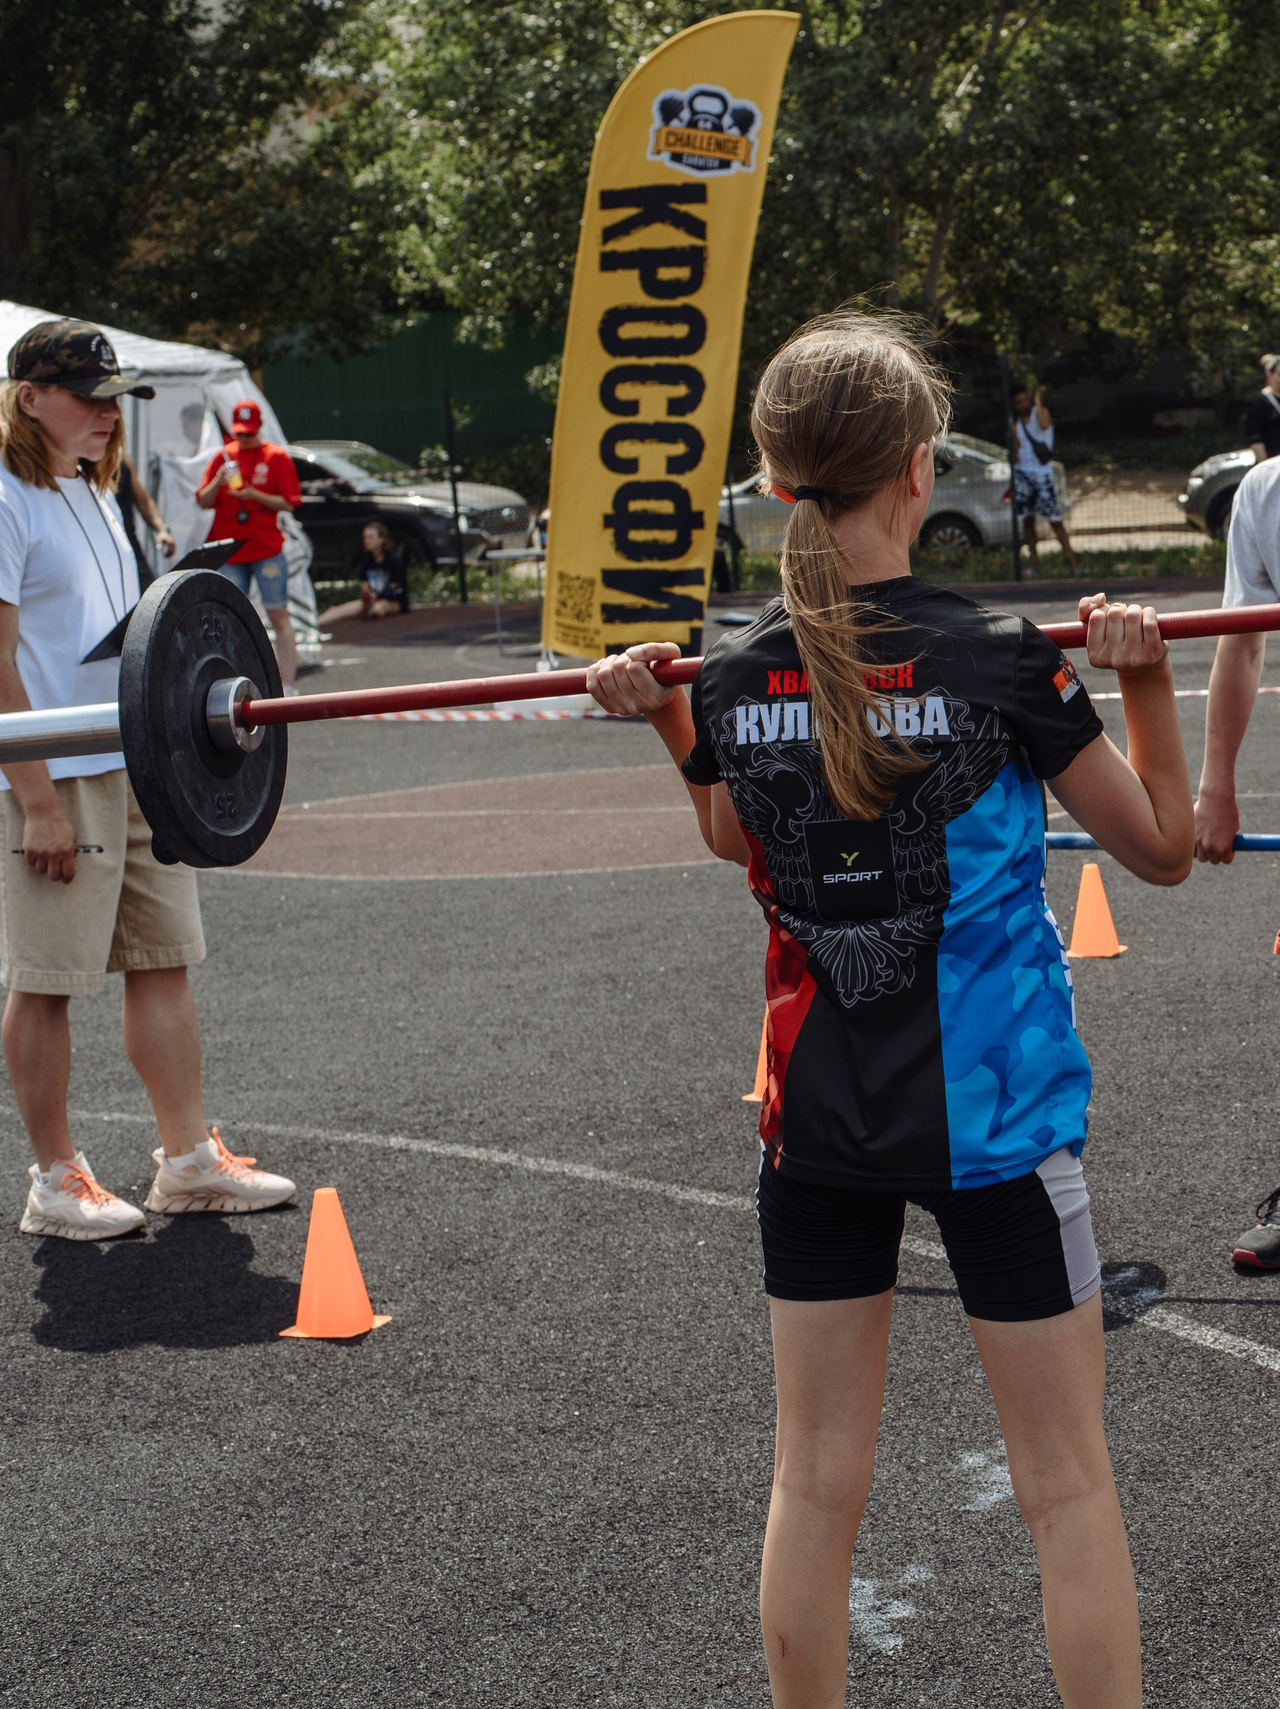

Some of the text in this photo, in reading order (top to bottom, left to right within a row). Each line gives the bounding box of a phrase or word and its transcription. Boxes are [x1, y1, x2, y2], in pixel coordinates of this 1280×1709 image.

[664, 130, 739, 156] CHALLENGE
[766, 662, 914, 695] ХВАНСК
[735, 696, 951, 746] КУЛОВА
[822, 870, 884, 884] SPORT
